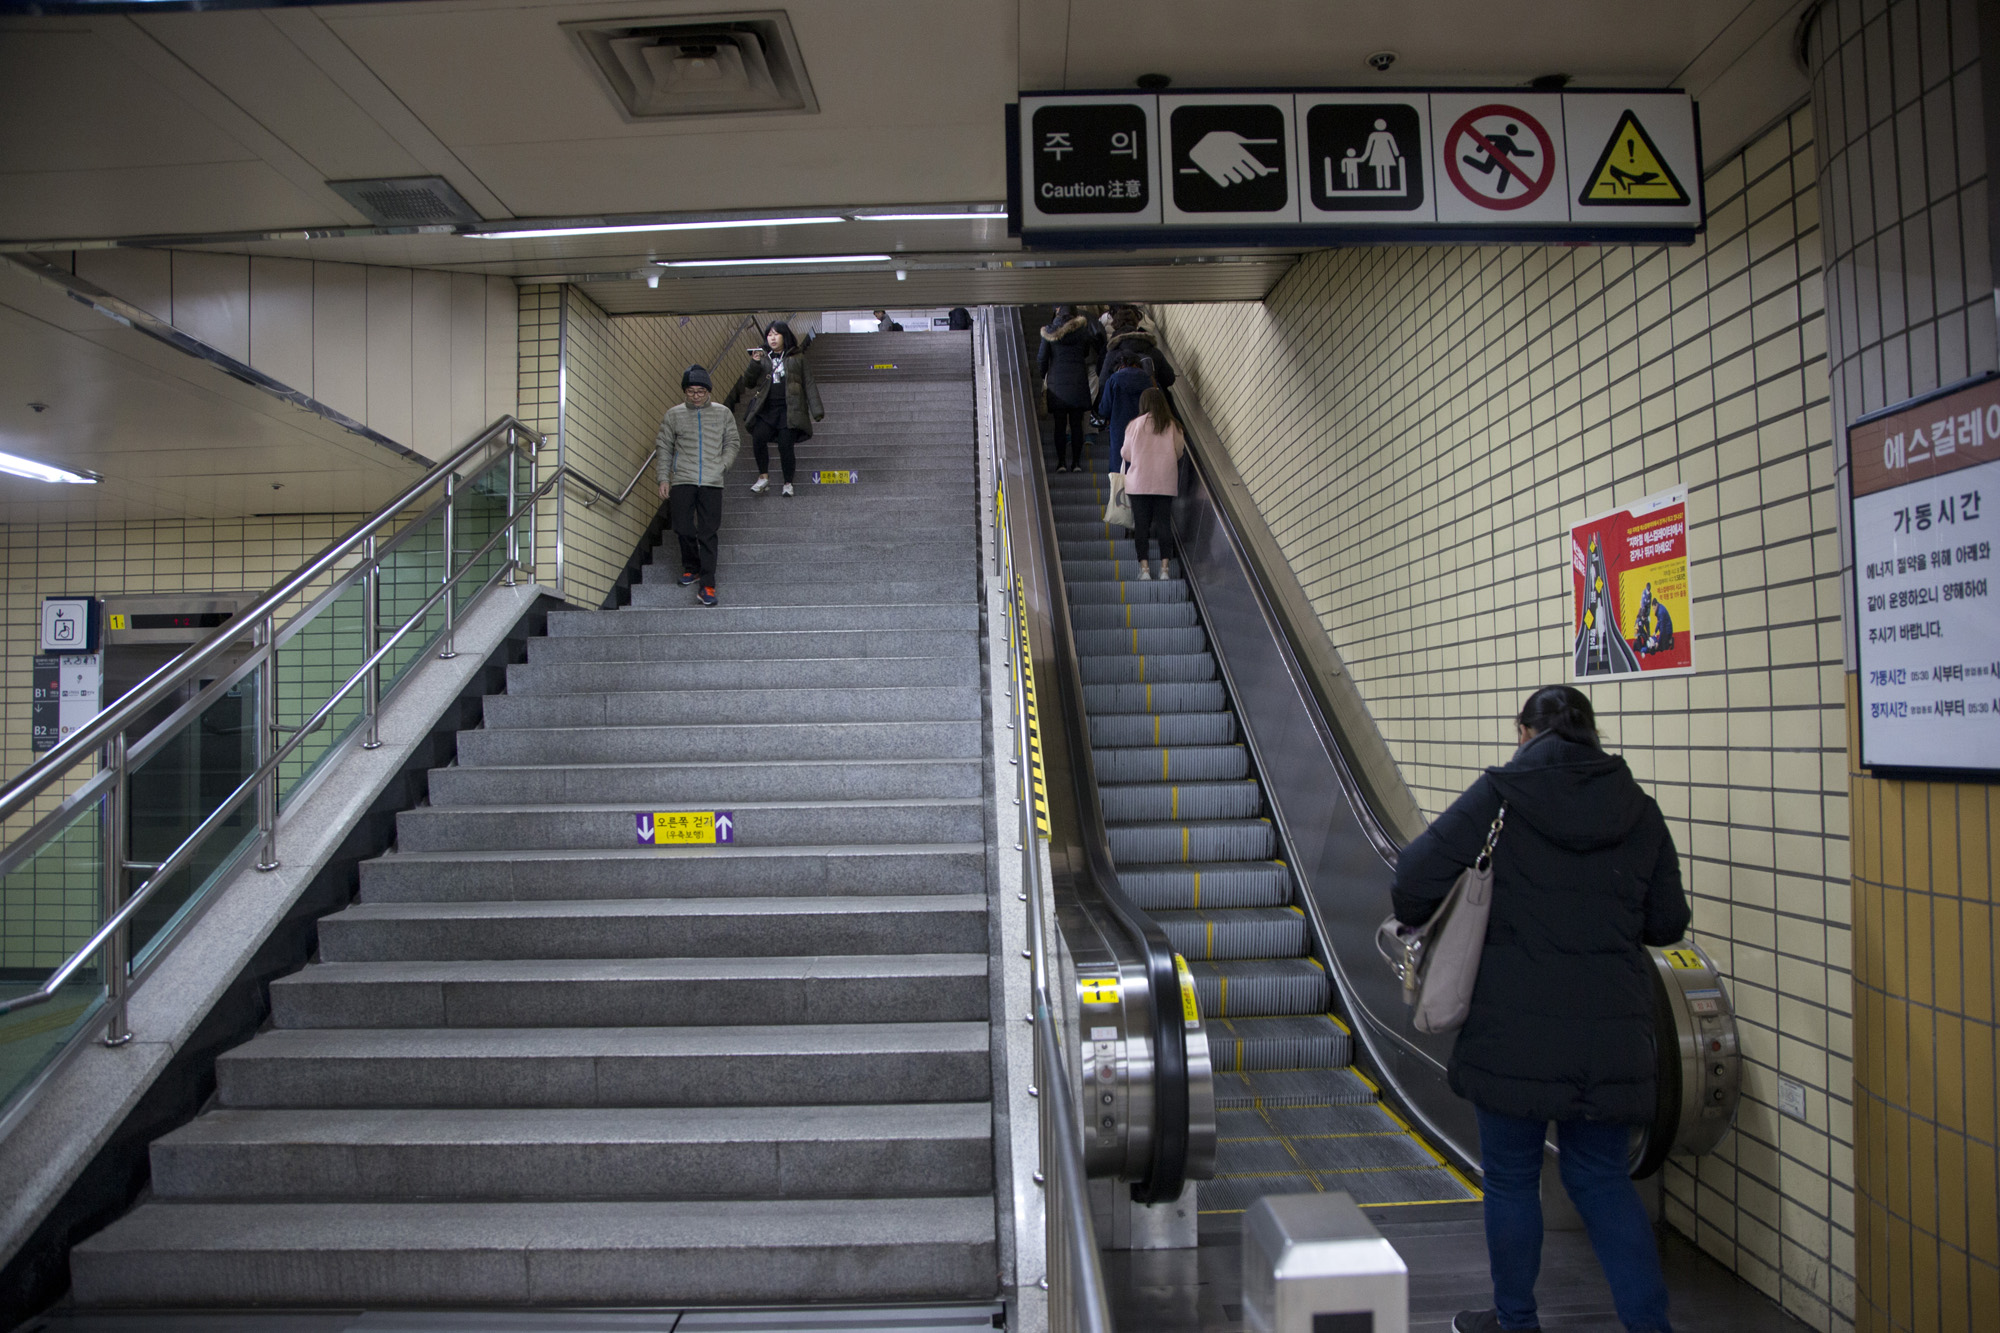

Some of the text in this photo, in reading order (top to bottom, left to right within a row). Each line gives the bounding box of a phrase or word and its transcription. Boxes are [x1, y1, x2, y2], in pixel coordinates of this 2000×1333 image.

[1041, 182, 1106, 198] Caution
[1108, 180, 1141, 198] 注意
[1893, 490, 1981, 535] 가동시간
[1866, 541, 1990, 579] 에너지 절약을 위해 아래와
[1867, 578, 1988, 612] 같이 운영하오니 양해하여
[113, 615, 119, 629] 1
[1869, 620, 1943, 644] 주시기 바랍니다.
[1870, 668, 1906, 686] 가동시간
[1911, 671, 1930, 681] 05:30
[1933, 664, 1964, 682] 시부터
[35, 688, 47, 698] B1
[1871, 702, 1908, 718] 정지시간
[1935, 699, 1965, 717] 시부터
[34, 726, 47, 736] B2
[657, 816, 713, 829] 오른쪽 걷기
